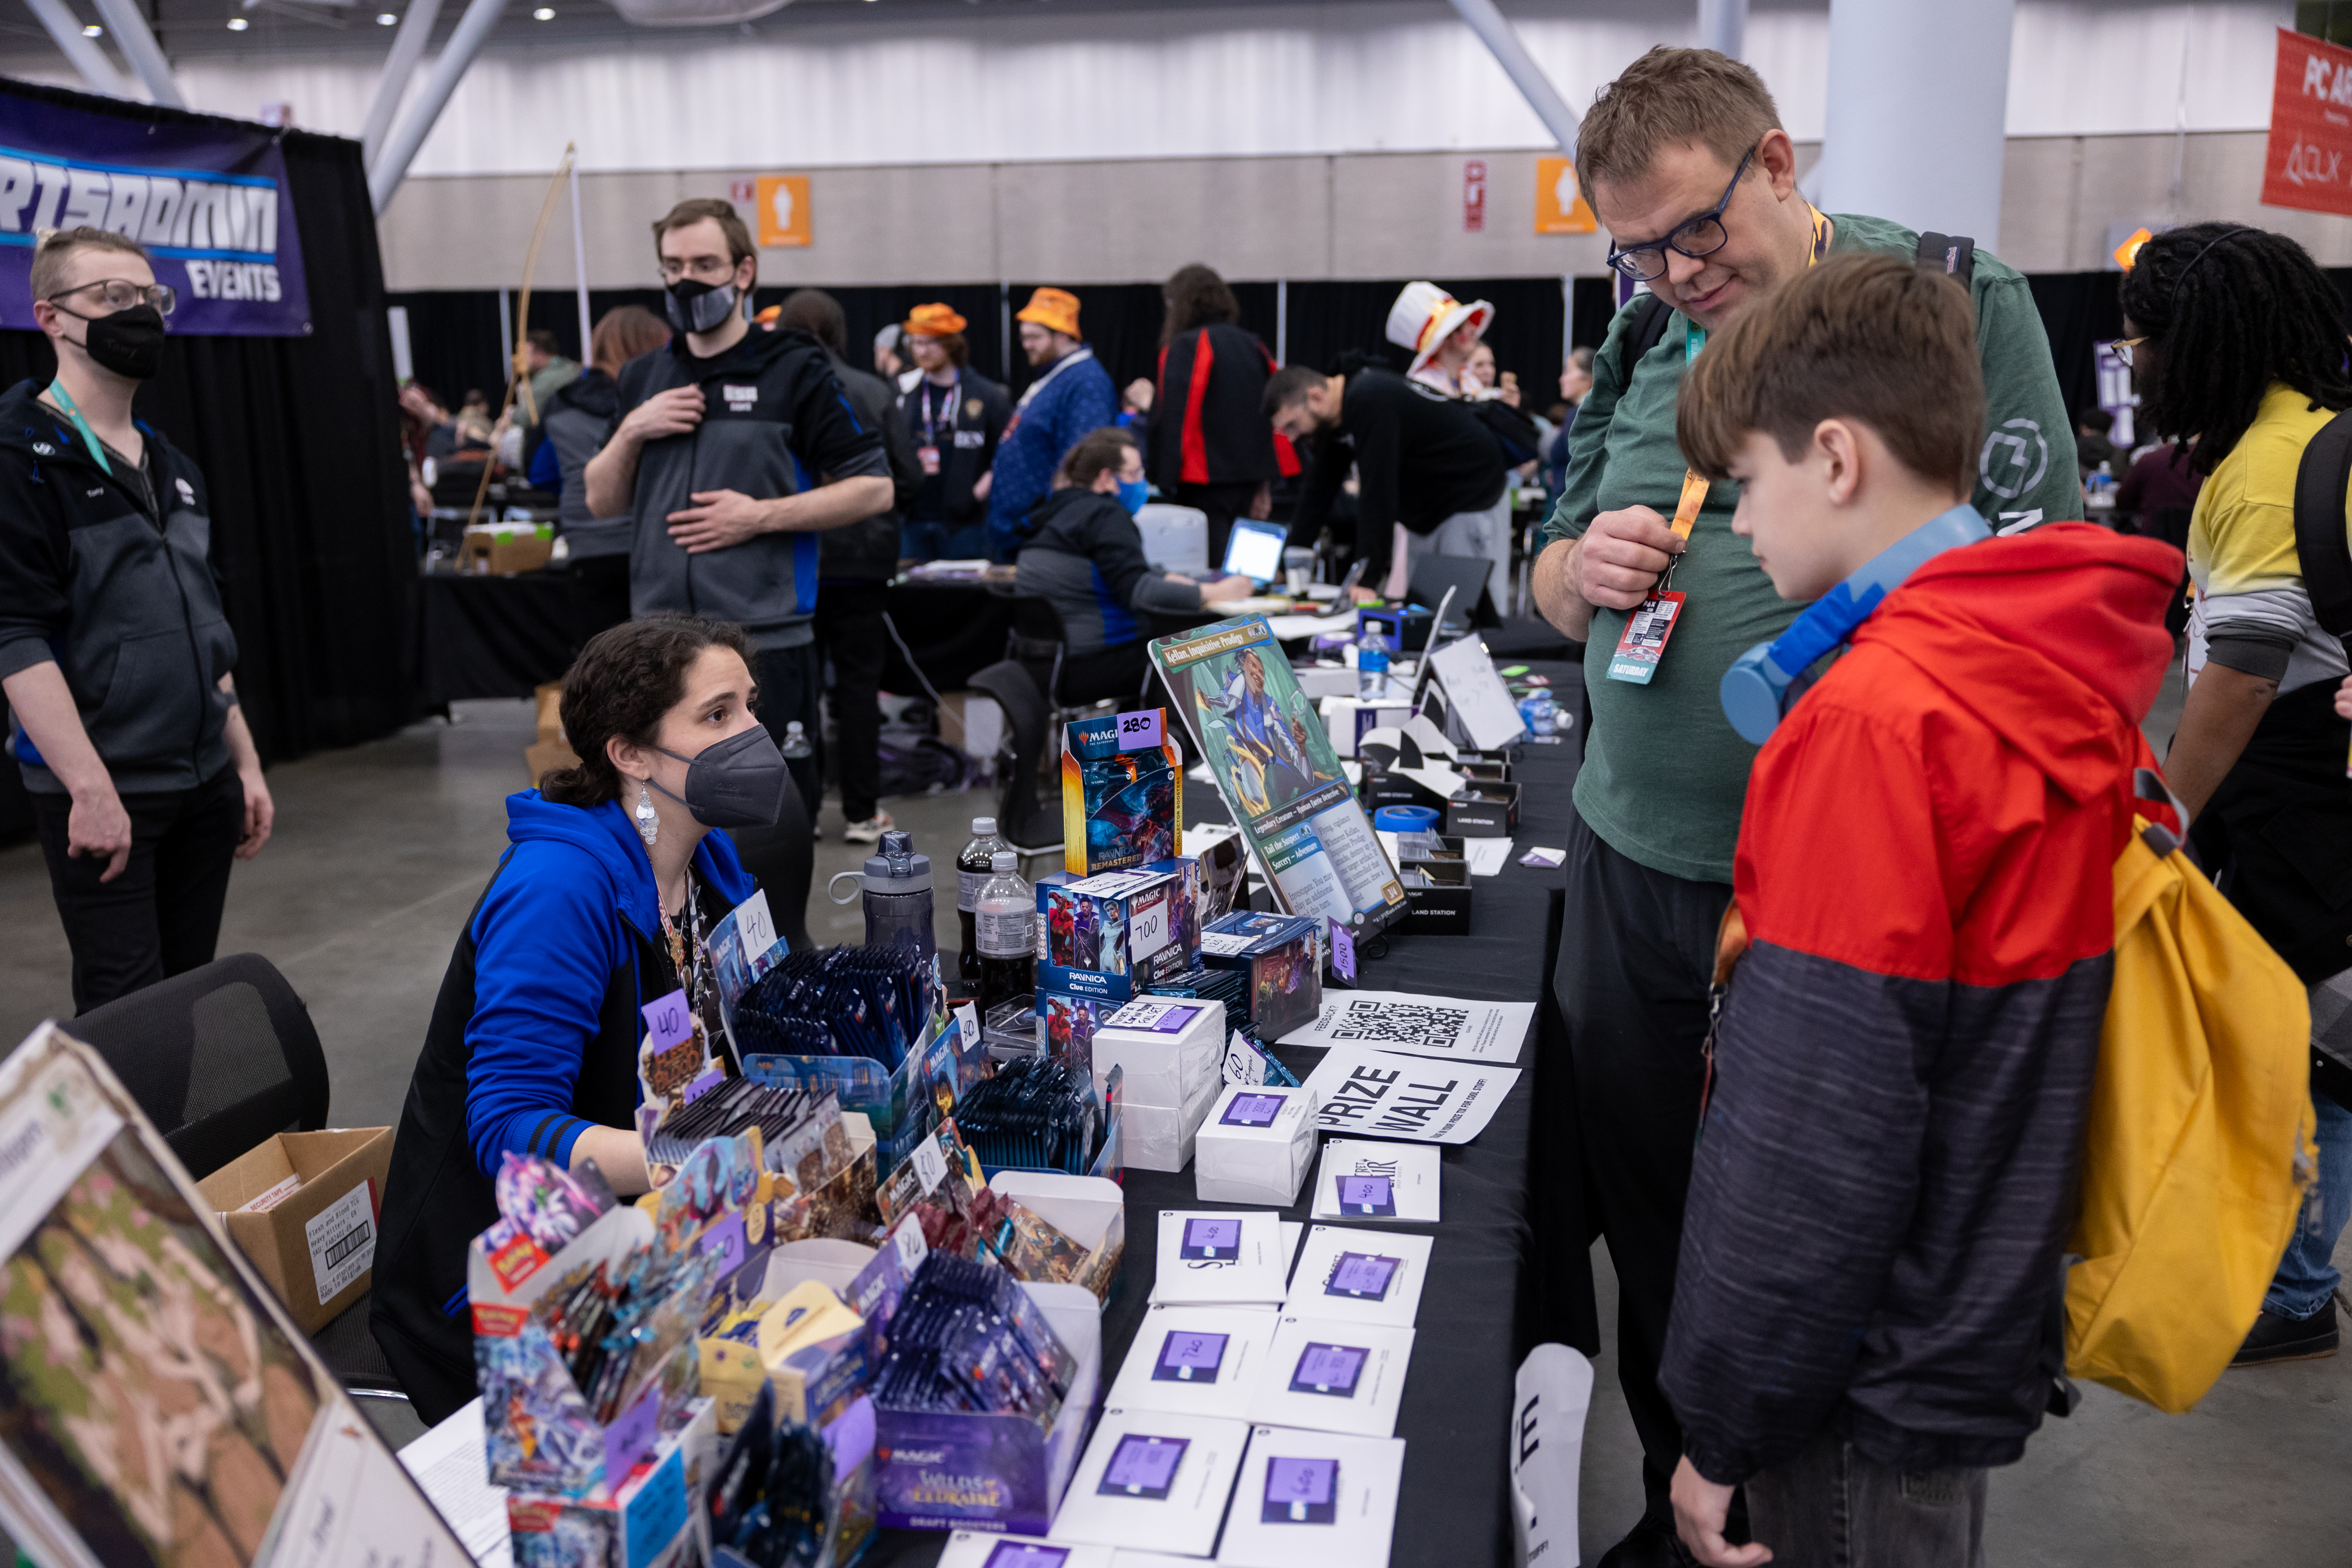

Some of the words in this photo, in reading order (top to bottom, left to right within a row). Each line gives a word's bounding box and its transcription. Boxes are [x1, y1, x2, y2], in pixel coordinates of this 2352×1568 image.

[2303, 54, 2332, 100] PC
[185, 260, 282, 301] EVENTS
[1165, 649, 1190, 664] Kellan,
[1187, 640, 1222, 656] Inquisitive
[1219, 633, 1244, 647] Prodigy
[1614, 664, 1648, 677] SATURDAY
[1089, 729, 1118, 742] MAGI
[1123, 717, 1151, 733] 280
[1254, 818, 1276, 834] Legendary
[1275, 811, 1293, 824] Creature
[1296, 803, 1311, 814] Human
[1310, 797, 1323, 808] Faerie
[1321, 789, 1340, 802] Detective
[1099, 846, 1135, 860] RAVNICA
[1264, 842, 1274, 854] Tail
[1274, 840, 1283, 850] the
[1281, 833, 1300, 846] Suspect
[1329, 842, 1351, 857] Inquisitive
[1350, 834, 1366, 845] Prodigy
[1350, 847, 1364, 858] destroy
[1091, 854, 1142, 871] REMASTERED
[1272, 855, 1291, 870] Sorcery
[1295, 842, 1318, 858] Adventure
[1348, 861, 1360, 871] target
[1371, 861, 1380, 869] that
[888, 878, 912, 888] pogo
[1288, 882, 1317, 901] Investigate.
[1313, 878, 1323, 887] You
[1323, 872, 1334, 882] may
[1387, 886, 1398, 899] 3/4
[1138, 888, 1161, 906] MAGIC
[1294, 900, 1306, 912] play
[1311, 884, 1334, 902] additional
[1311, 904, 1320, 913] this
[1320, 899, 1332, 910] turn.
[747, 911, 767, 947] 40
[1135, 915, 1158, 941] 700
[1154, 943, 1182, 966] RAVNICA
[1339, 943, 1348, 968] 1500
[1069, 972, 1107, 984] RAVNICA
[1154, 968, 1165, 980] Clue
[1165, 959, 1183, 973] EDITION
[1084, 986, 1108, 994] EDITION
[657, 1007, 679, 1037] 40
[1139, 1014, 1156, 1023] FULL
[1161, 1012, 1176, 1026] 2400
[1314, 1005, 1339, 1031] FEEDBACK?
[930, 1041, 950, 1071] MAGIC
[1228, 1053, 1243, 1079] 60
[654, 1051, 699, 1092] BLOOD
[1253, 1102, 1268, 1113] 3200
[1318, 1065, 1401, 1127] PRIZE
[1367, 1080, 1459, 1132] WALL
[1449, 1114, 1463, 1123] PRIZE
[1466, 1091, 1479, 1100] COOL
[1473, 1078, 1488, 1091] STUFF!
[889, 1168, 916, 1202] MAGIC
[1359, 1184, 1373, 1198] 400
[251, 1195, 272, 1211] SECURITY
[271, 1187, 284, 1200] TAPE
[309, 1222, 324, 1239] Flesh
[325, 1215, 334, 1227] and
[335, 1203, 349, 1219] Blood
[351, 1196, 359, 1208] TCG
[310, 1233, 325, 1250] Heavy
[326, 1218, 345, 1237] Hitters
[351, 1208, 357, 1218] EN
[312, 1244, 323, 1257] SKU:
[320, 1286, 333, 1300] Made
[334, 1279, 340, 1289] in
[341, 1262, 361, 1285] Belgium
